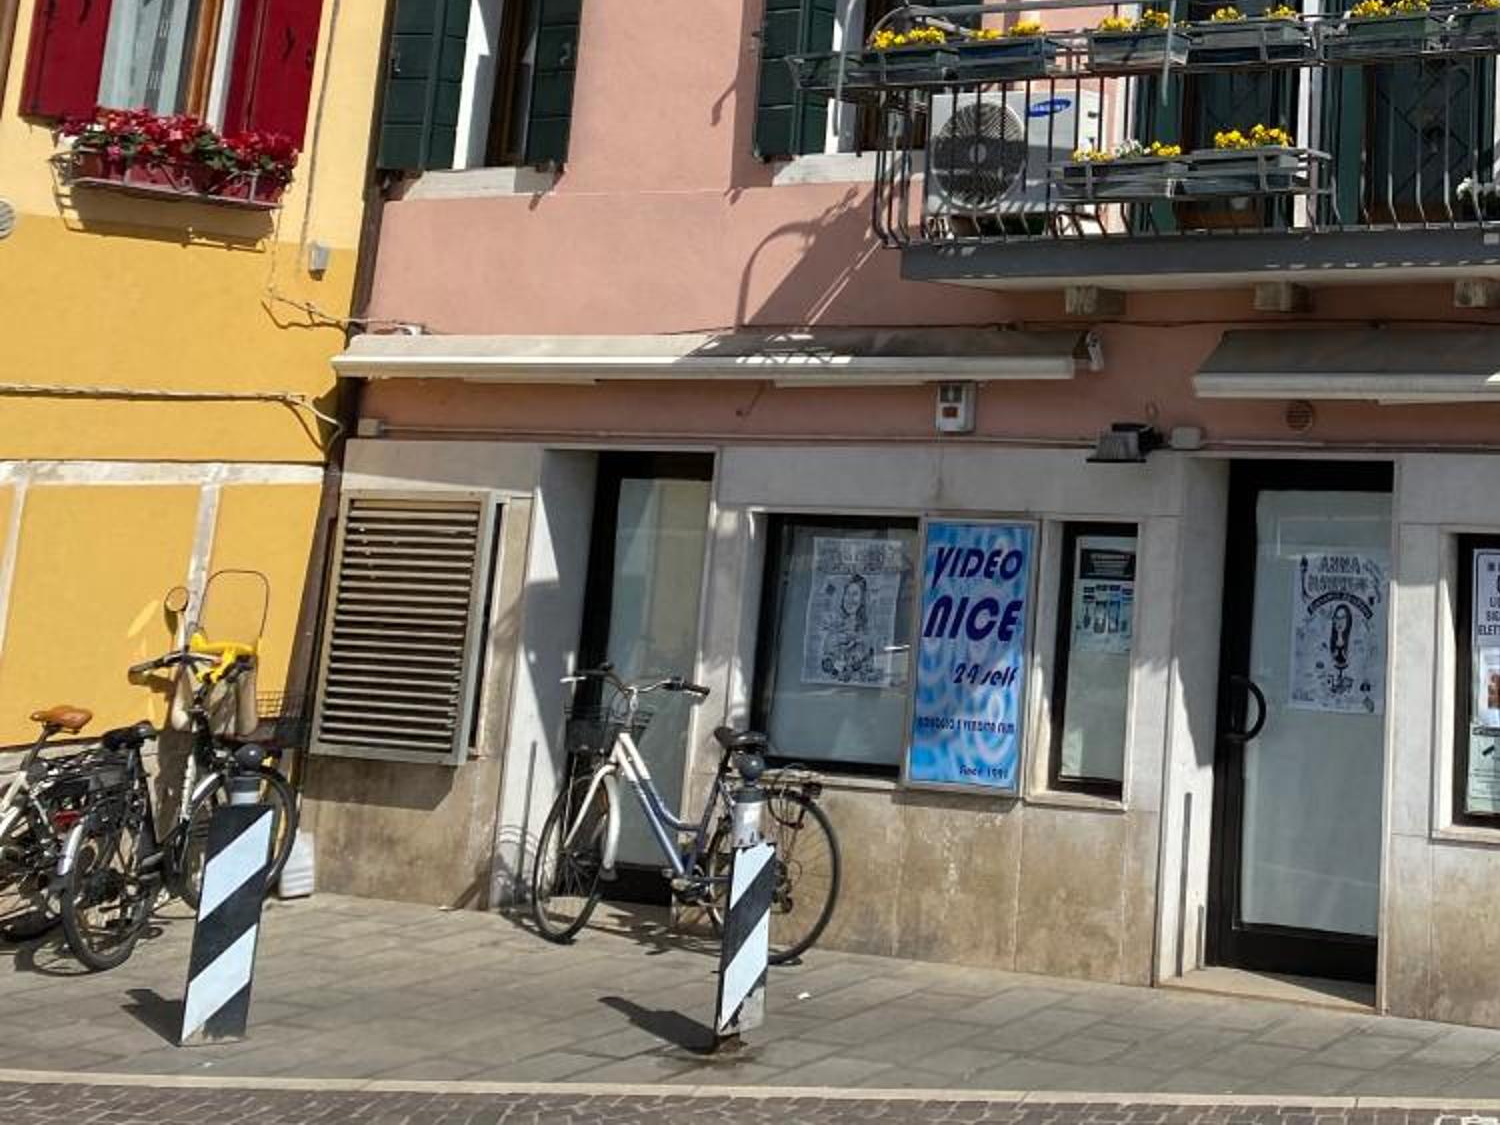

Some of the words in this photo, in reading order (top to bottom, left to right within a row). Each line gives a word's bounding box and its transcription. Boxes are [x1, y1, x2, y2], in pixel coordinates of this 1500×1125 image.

[931, 546, 1023, 589] VIDEO
[923, 595, 1025, 642] NICE
[953, 662, 981, 684] 24
